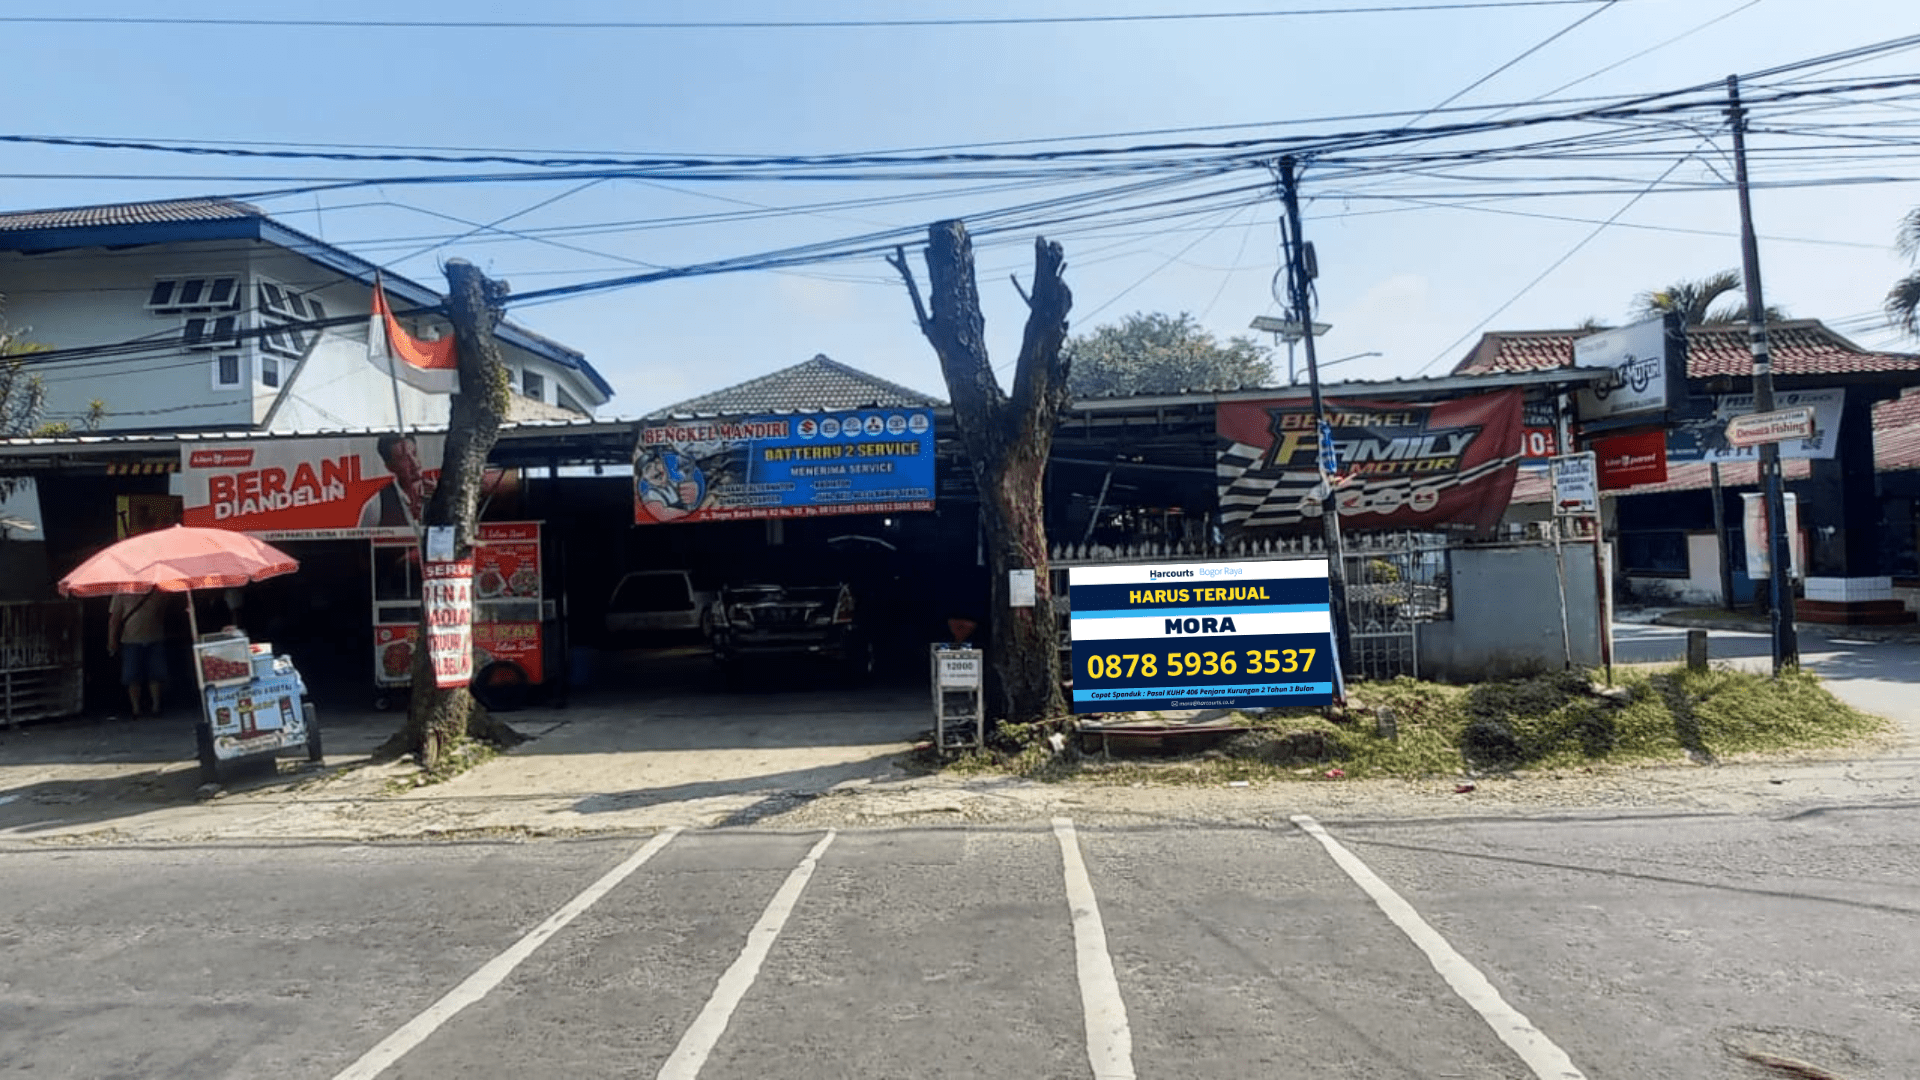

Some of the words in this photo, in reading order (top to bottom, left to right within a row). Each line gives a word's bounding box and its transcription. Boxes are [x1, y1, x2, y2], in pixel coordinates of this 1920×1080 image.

[1280, 412, 1419, 431] BENGKEL
[644, 426, 717, 444] BENGKEL
[720, 420, 788, 440] MANDIRI
[857, 442, 919, 457] SERVICE
[1274, 432, 1475, 465] FAMILY
[1350, 457, 1457, 475] MOTOR
[208, 453, 361, 503] BERANI
[214, 485, 345, 521] DIANDELIN
[1149, 569, 1195, 578] Harcourts
[1199, 567, 1223, 579] Bogor
[1224, 566, 1243, 577] Raya
[1129, 588, 1190, 604] HARUS
[1193, 586, 1270, 602] TERJUAL
[1164, 616, 1237, 635] MORA
[1087, 653, 1158, 679] 0878
[1167, 650, 1238, 676] 5936
[1245, 648, 1317, 674] 3537
[1112, 690, 1142, 699] Spanduk
[1146, 689, 1166, 697] Pasal
[1166, 688, 1185, 696] KUHP
[1199, 687, 1226, 696] Penjara
[1227, 686, 1260, 695] Kurungan
[1267, 685, 1288, 693] Tahun
[1295, 684, 1315, 692] Bulan
